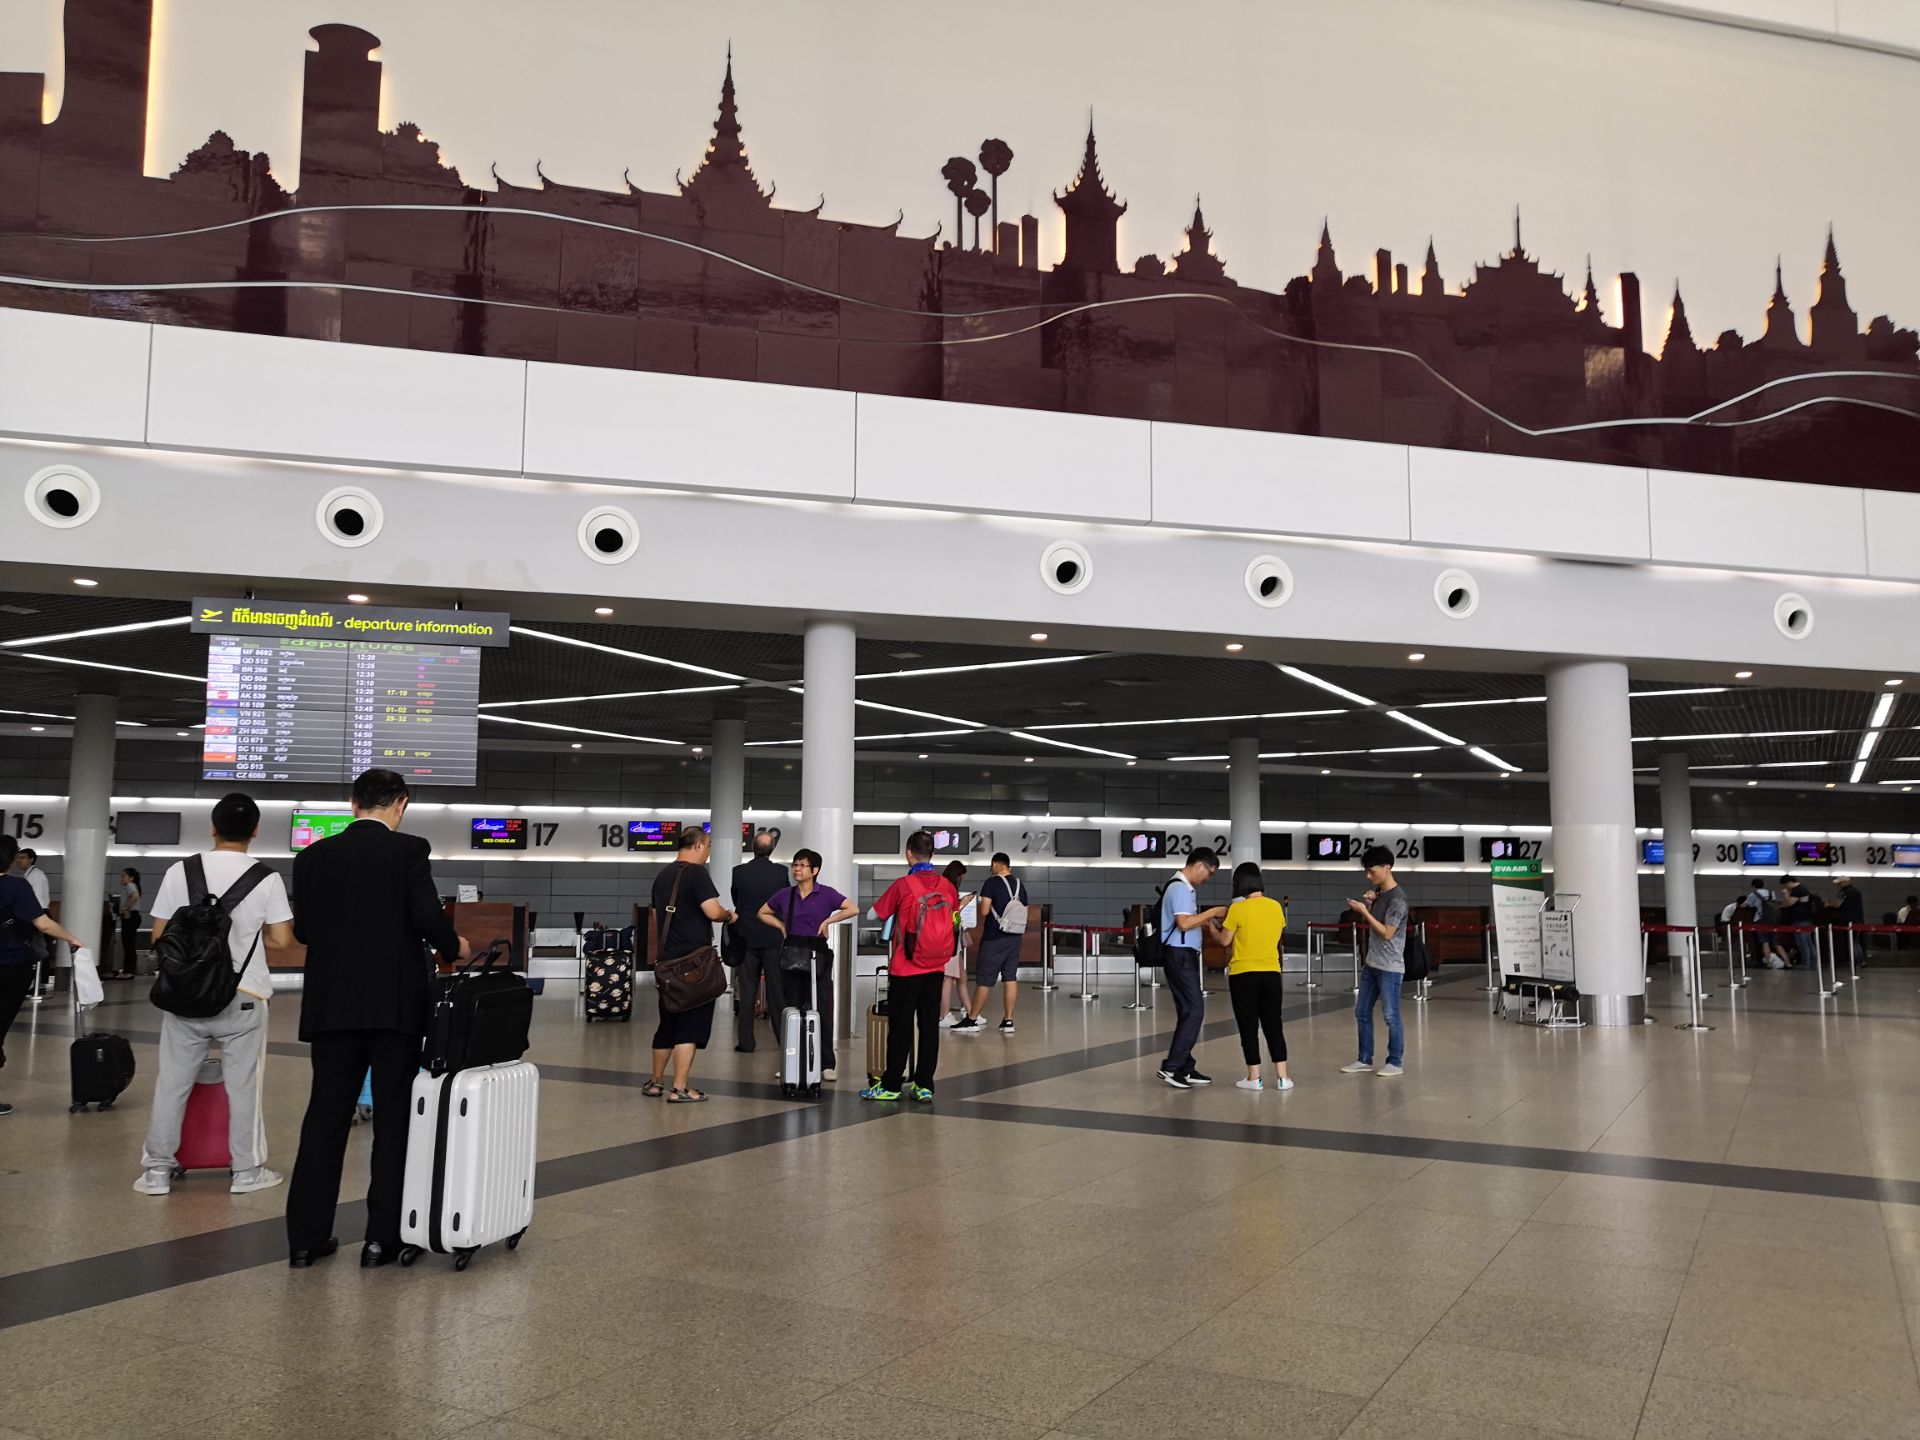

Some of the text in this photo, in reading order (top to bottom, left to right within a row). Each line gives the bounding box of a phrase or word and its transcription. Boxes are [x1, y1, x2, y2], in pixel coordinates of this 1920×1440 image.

[344, 617, 413, 632] departure
[416, 620, 493, 635] information
[290, 638, 415, 652] departures
[12, 813, 44, 839] 15
[532, 822, 559, 846] 17
[598, 823, 625, 848] 18
[970, 831, 994, 853] 21
[1021, 831, 1050, 853] 22
[1166, 834, 1193, 856] 23
[1214, 835, 1232, 856] 2
[1396, 838, 1420, 859] 26
[1520, 840, 1543, 860] 27
[1716, 844, 1739, 863] 30
[1830, 846, 1847, 865] 31
[1866, 846, 1888, 866] 32
